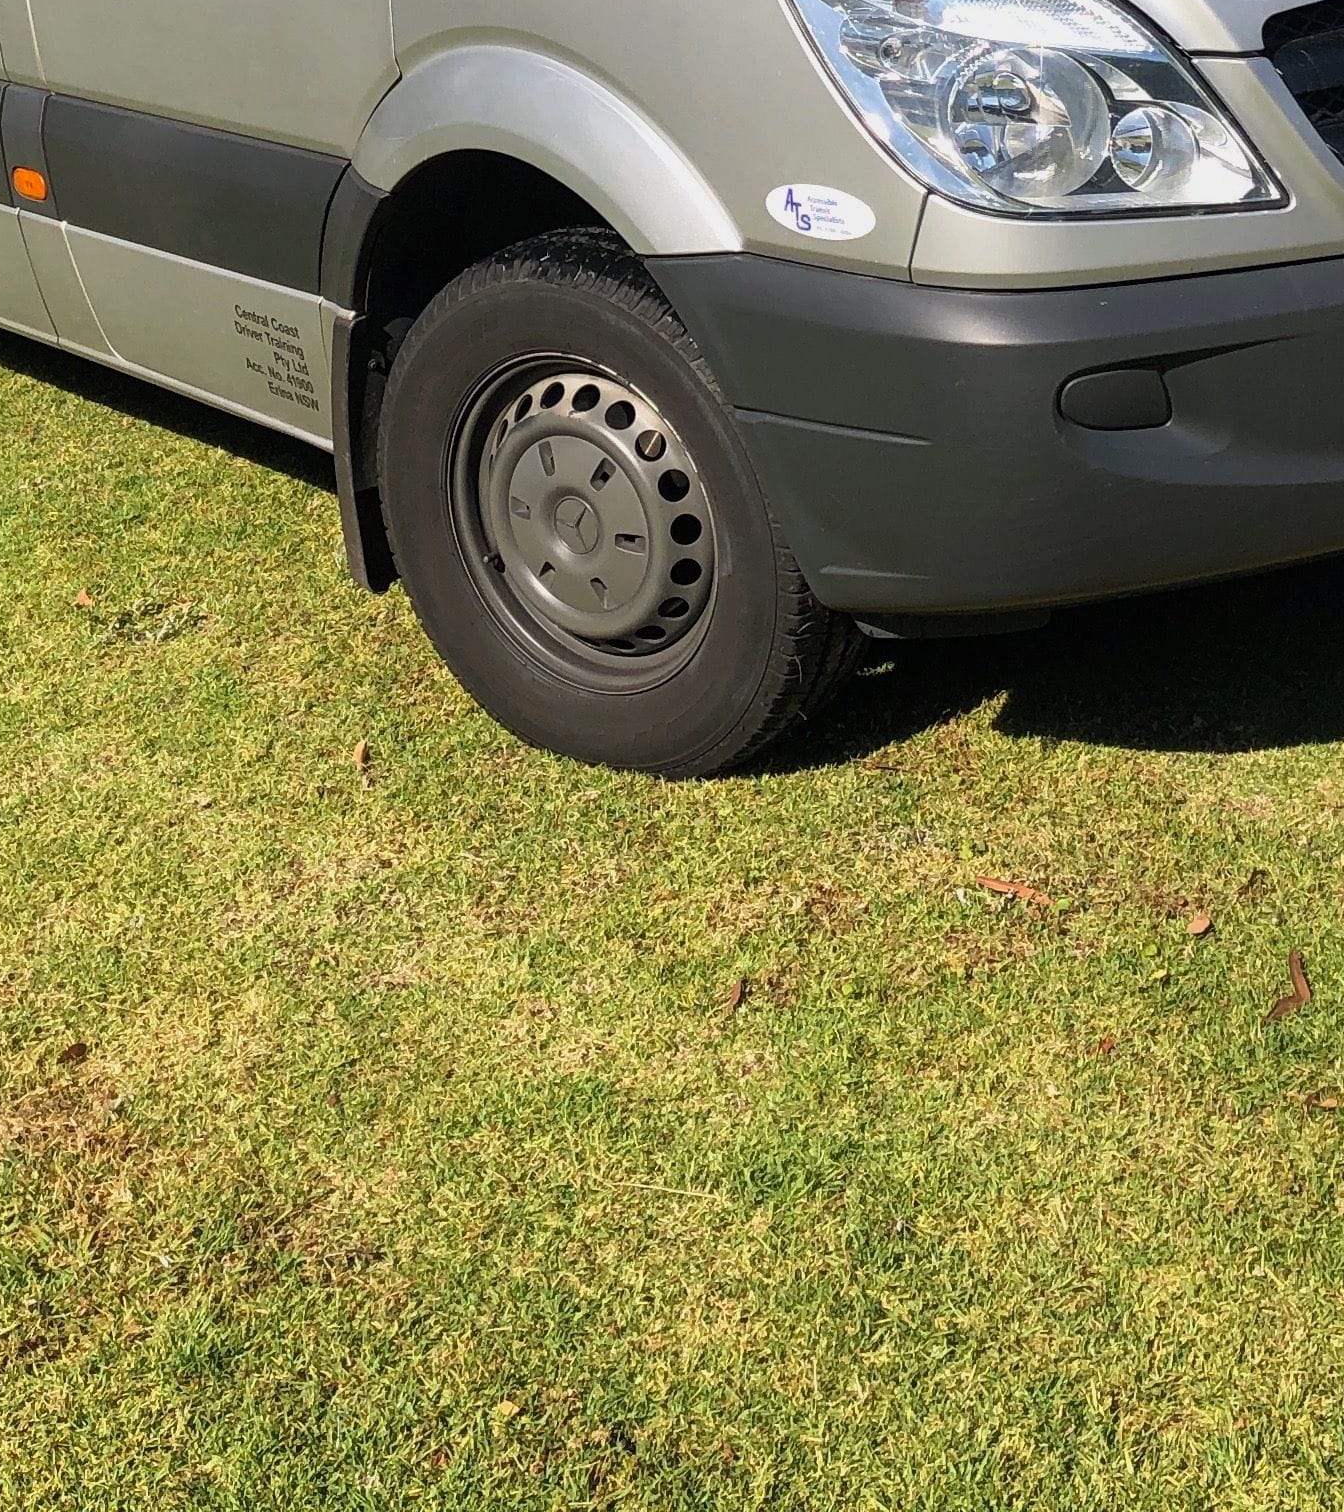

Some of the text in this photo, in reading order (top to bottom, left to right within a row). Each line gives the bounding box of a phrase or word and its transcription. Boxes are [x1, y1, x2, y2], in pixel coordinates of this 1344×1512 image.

[234, 304, 300, 339] Central Coast
[234, 321, 305, 360] Driver Training
[273, 351, 309, 376] Pty Ltd
[295, 392, 320, 412] NSW
